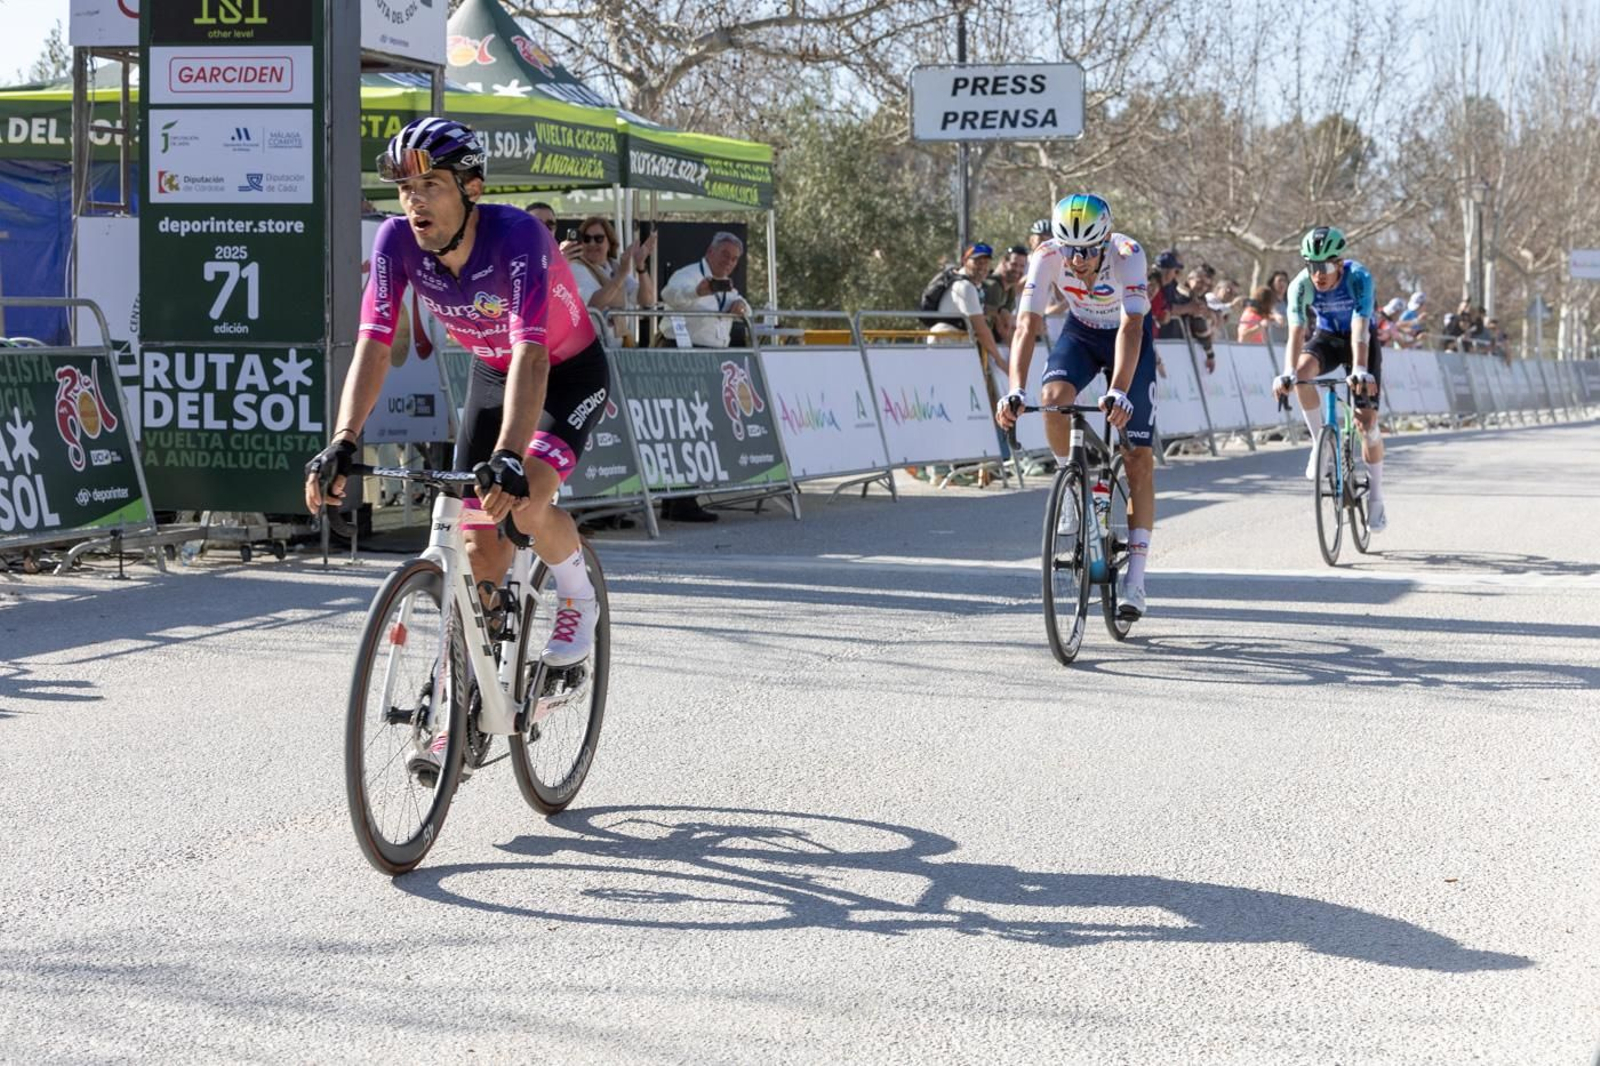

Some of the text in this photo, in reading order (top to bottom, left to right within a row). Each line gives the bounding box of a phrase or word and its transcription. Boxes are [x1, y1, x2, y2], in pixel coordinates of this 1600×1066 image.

[208, 29, 254, 38] other level
[178, 66, 284, 84] GARCIDEN
[951, 74, 1047, 97] PRESS
[8, 117, 65, 145] DEL
[941, 109, 1058, 131] PRENSA
[494, 131, 522, 158] SOL
[535, 122, 617, 154] VUELTA CICLISTA
[531, 153, 605, 180] A ANDALUCÍA
[629, 150, 658, 177] RUTA
[183, 175, 224, 185] Diputación
[266, 173, 305, 184] Diputación
[158, 216, 305, 237] deporinter.store
[215, 246, 248, 260] 2025
[203, 261, 260, 320] 71
[130, 293, 140, 333] CENT
[213, 322, 249, 334] edición
[143, 351, 271, 392] RUTA
[143, 391, 323, 432] DEL SOL
[388, 397, 405, 414] UCI
[628, 398, 696, 441] RUTA
[144, 430, 322, 452] VUELTA CICLISTA
[144, 451, 159, 468] A
[164, 449, 290, 471] ANDALUCÍA
[638, 440, 729, 485] DEL SOL
